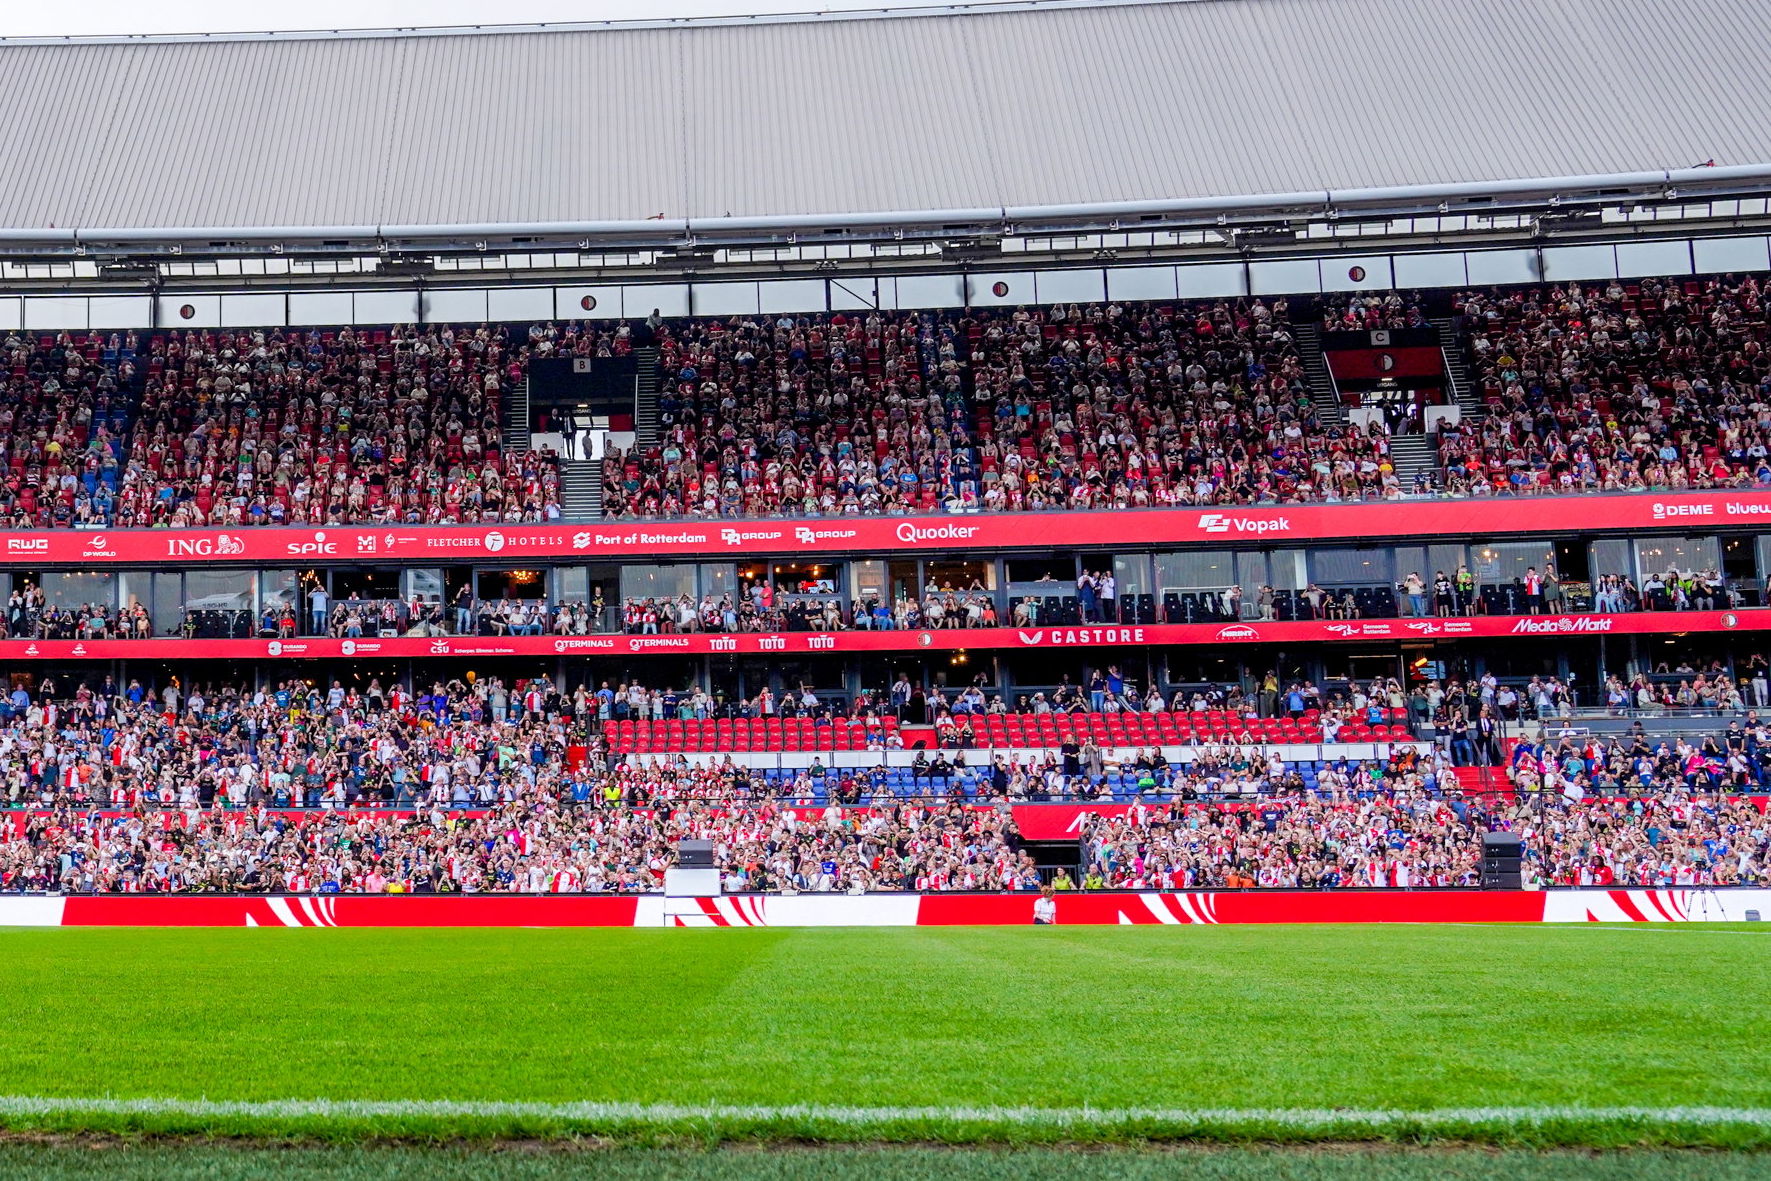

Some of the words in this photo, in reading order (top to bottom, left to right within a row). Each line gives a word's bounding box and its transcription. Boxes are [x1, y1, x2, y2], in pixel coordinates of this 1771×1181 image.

[1375, 332, 1385, 342] C
[579, 360, 586, 370] B
[1666, 504, 1714, 516] DEME
[1234, 517, 1290, 534] Vopak
[595, 534, 622, 545] Port
[624, 533, 638, 544] of
[640, 532, 706, 544] Rotterdam
[741, 532, 782, 540] GROUP
[816, 530, 857, 538] GROUP
[896, 522, 976, 543] Quooker
[7, 539, 48, 549] RWG
[167, 539, 213, 555] ING
[427, 538, 481, 547] FLETCHER
[508, 536, 563, 546] HOTELS
[1512, 619, 1558, 632] Media
[1571, 617, 1612, 631] Markt
[759, 636, 786, 650] TOTO
[808, 635, 835, 649] TOTO
[1052, 629, 1144, 644] CASTORE
[554, 640, 614, 652] QTERMINALS
[630, 638, 689, 651] QTERMINALS
[710, 637, 737, 650] TOTO
